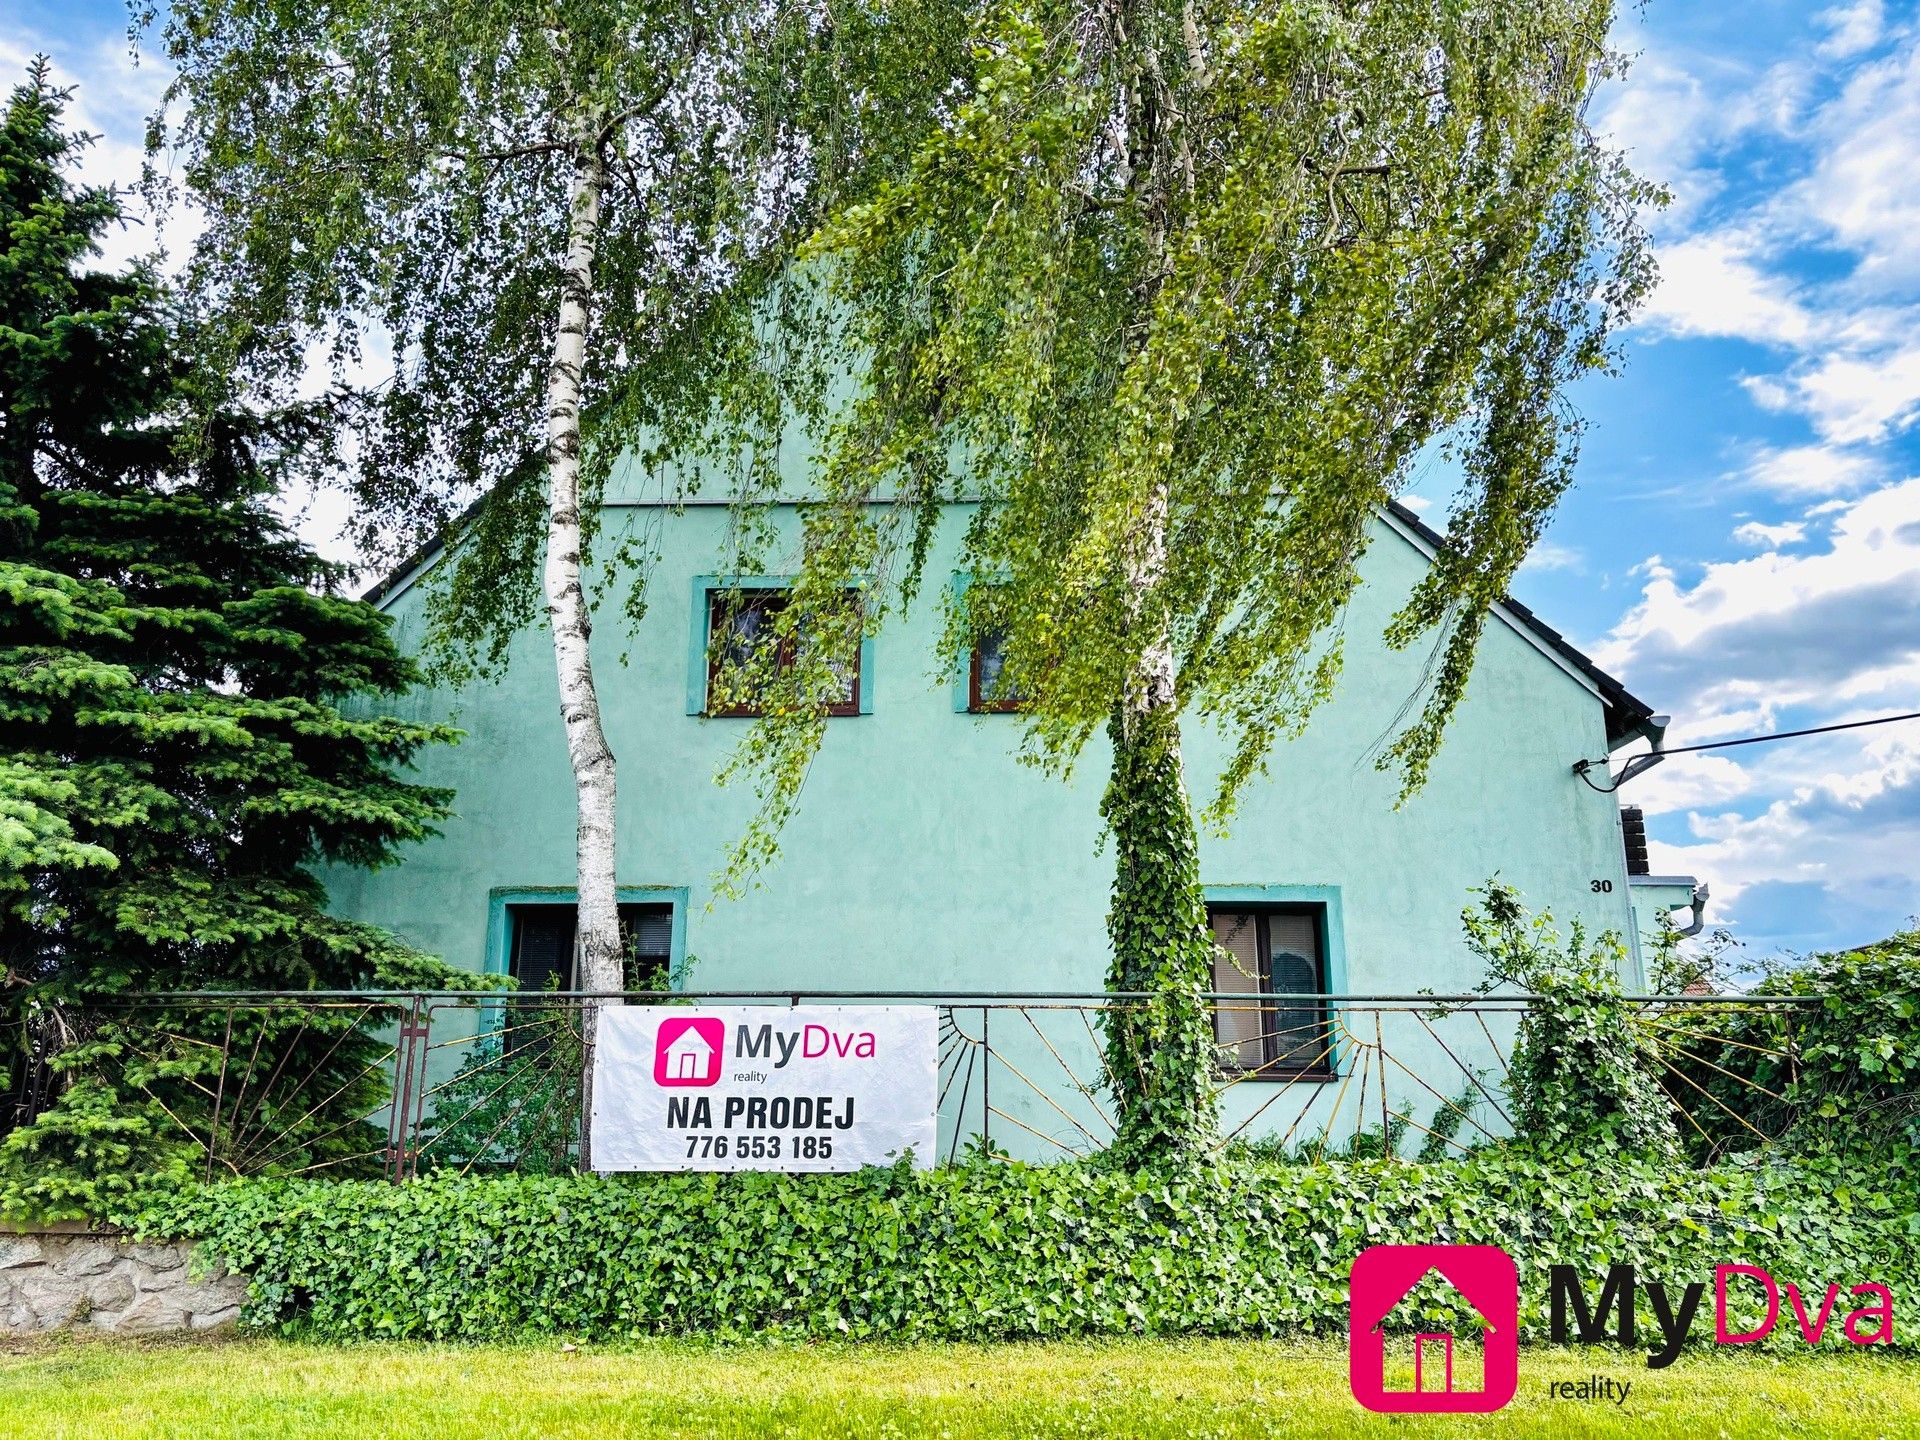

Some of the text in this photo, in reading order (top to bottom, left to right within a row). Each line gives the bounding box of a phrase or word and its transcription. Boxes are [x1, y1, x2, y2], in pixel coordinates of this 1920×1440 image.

[1590, 879, 1612, 893] 30
[734, 1023, 876, 1068] MyDva
[733, 1070, 768, 1084] reality
[666, 1096, 855, 1130] NA PRODEJ
[685, 1135, 833, 1159] 776 553 185
